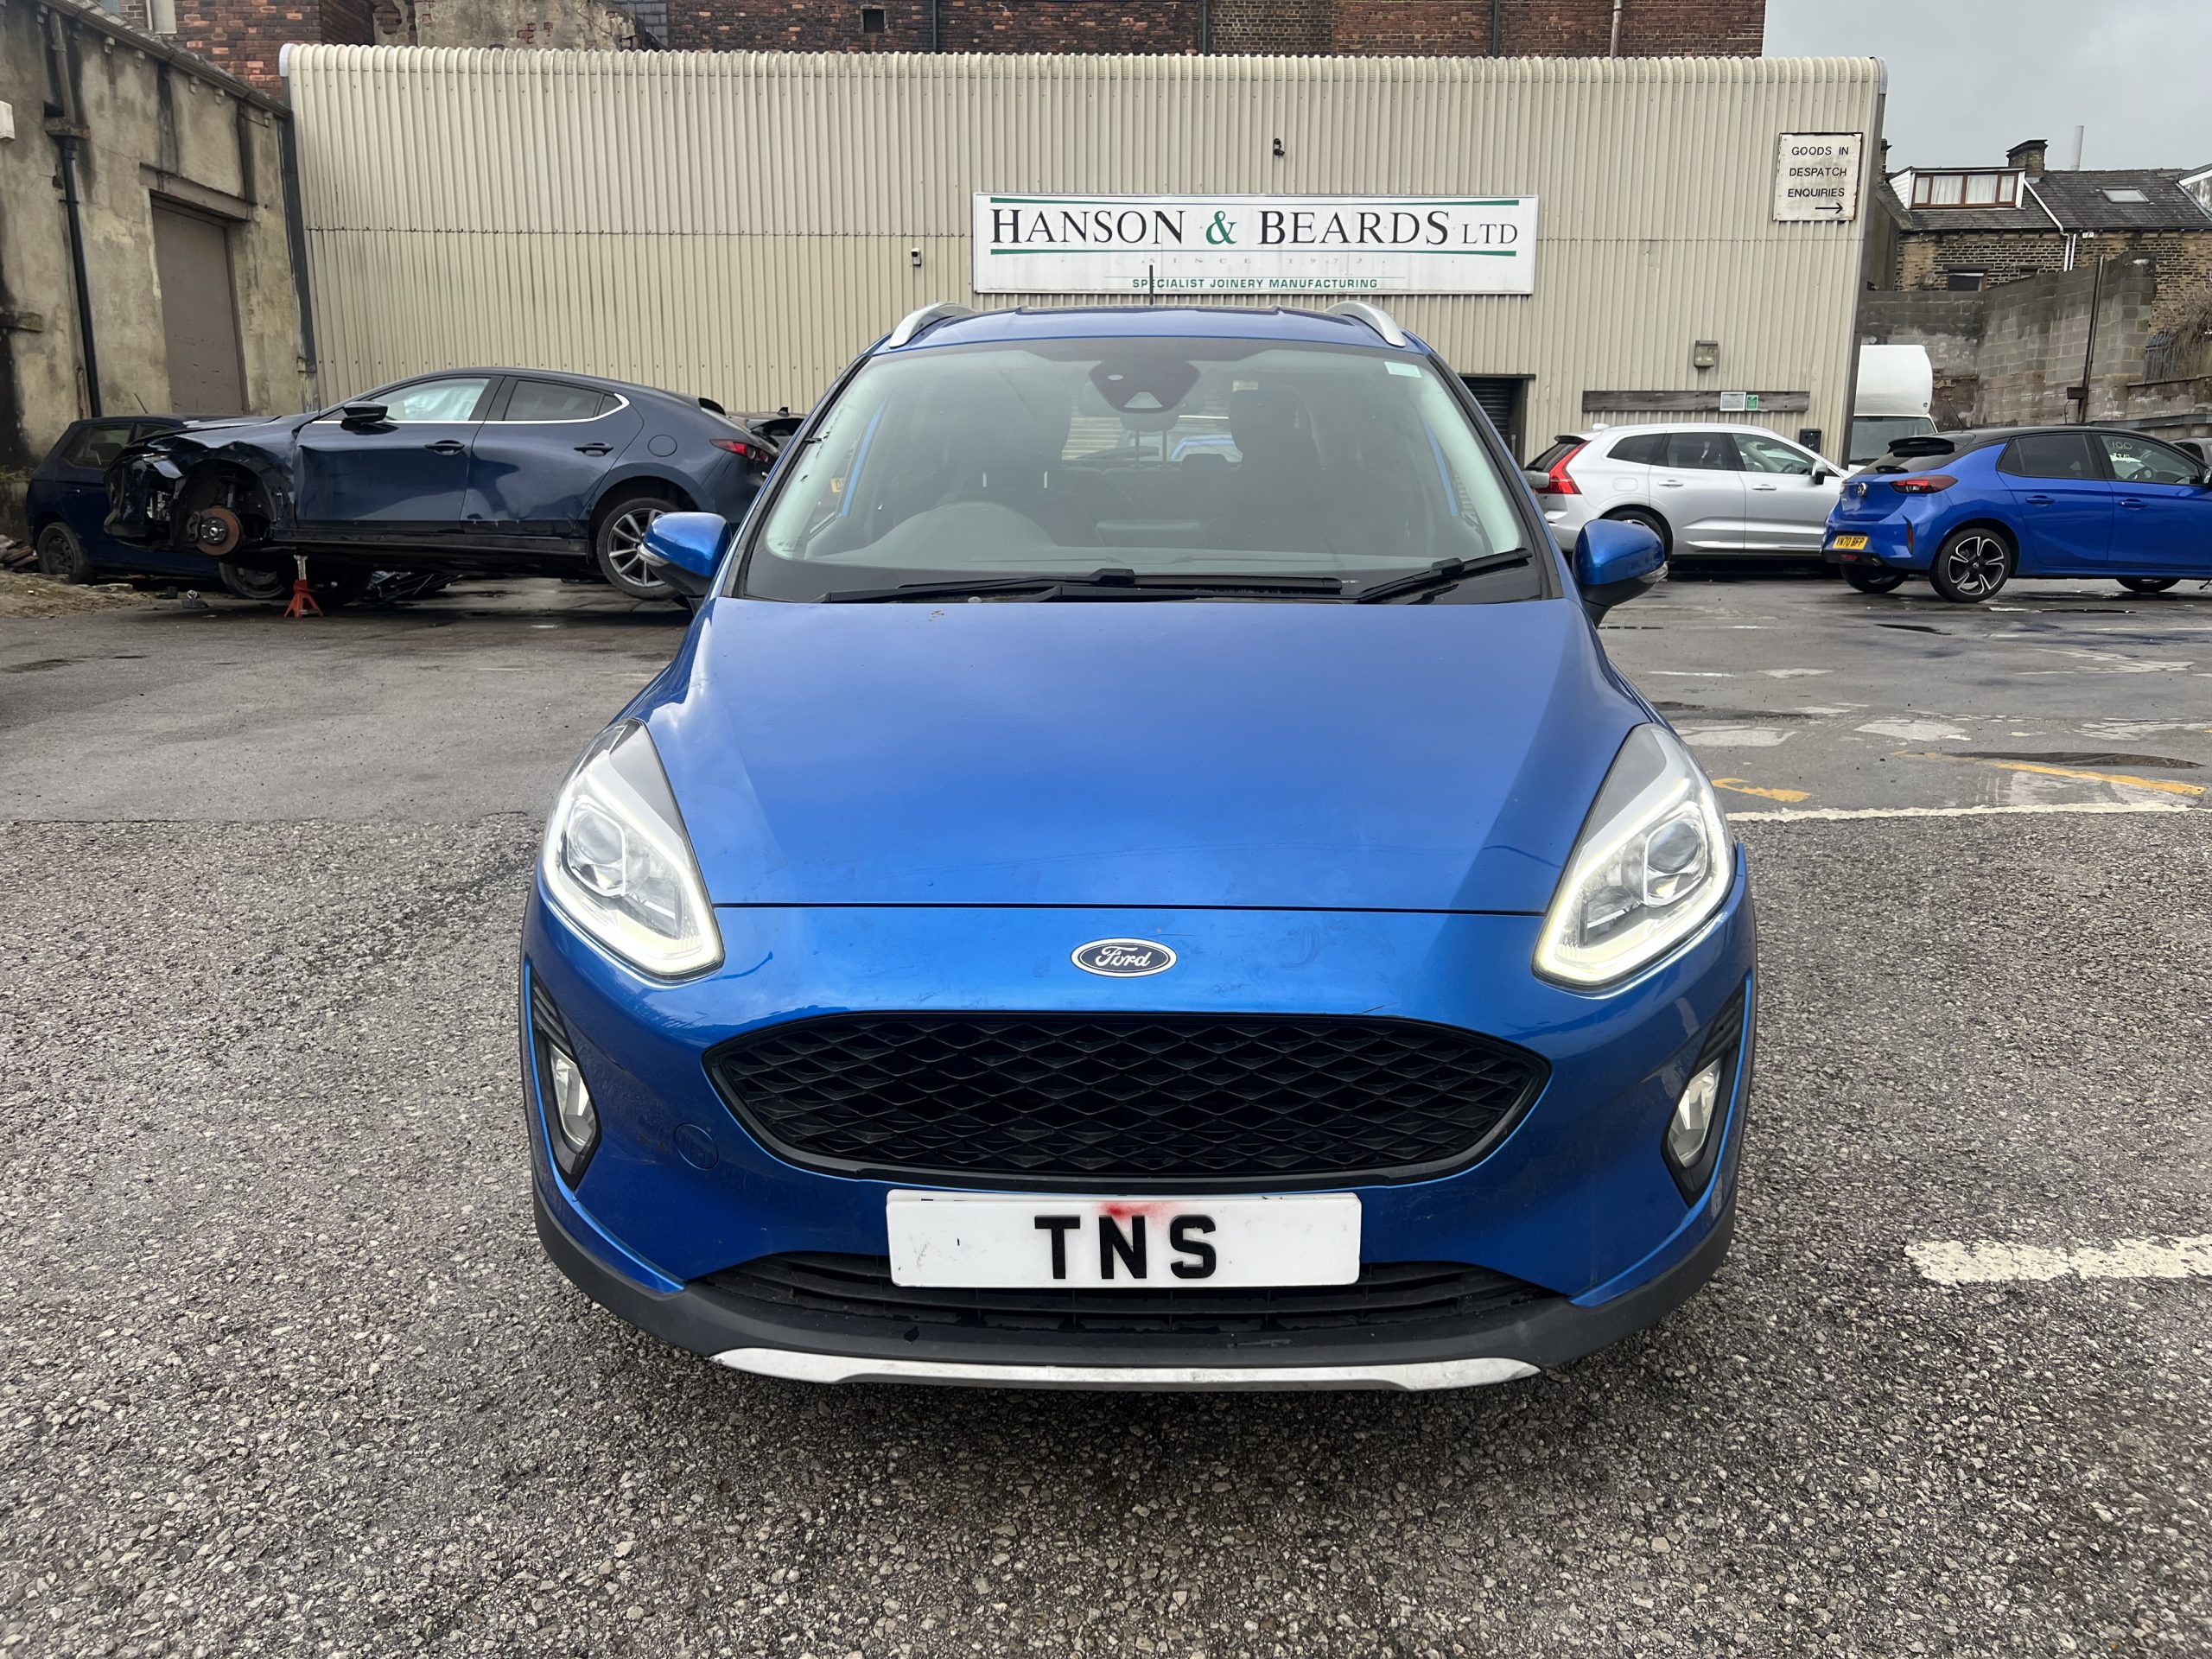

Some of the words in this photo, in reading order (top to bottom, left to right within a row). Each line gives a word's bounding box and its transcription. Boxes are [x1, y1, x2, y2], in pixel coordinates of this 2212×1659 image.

[1791, 146, 1832, 156] GOODS
[1839, 146, 1849, 156] IN
[1789, 167, 1847, 176] DESPATCH
[1787, 188, 1845, 197] ENQUIRIES
[990, 208, 1186, 245] HANSON
[1205, 210, 1237, 245] &
[1257, 210, 1449, 245] BEARDS
[1461, 223, 1518, 245] LTD
[1210, 278, 1263, 288] JOINERY
[1269, 278, 1377, 288] MANUFACTURING
[1095, 945, 1153, 967] Ford
[1034, 1214, 1217, 1281] TNS
